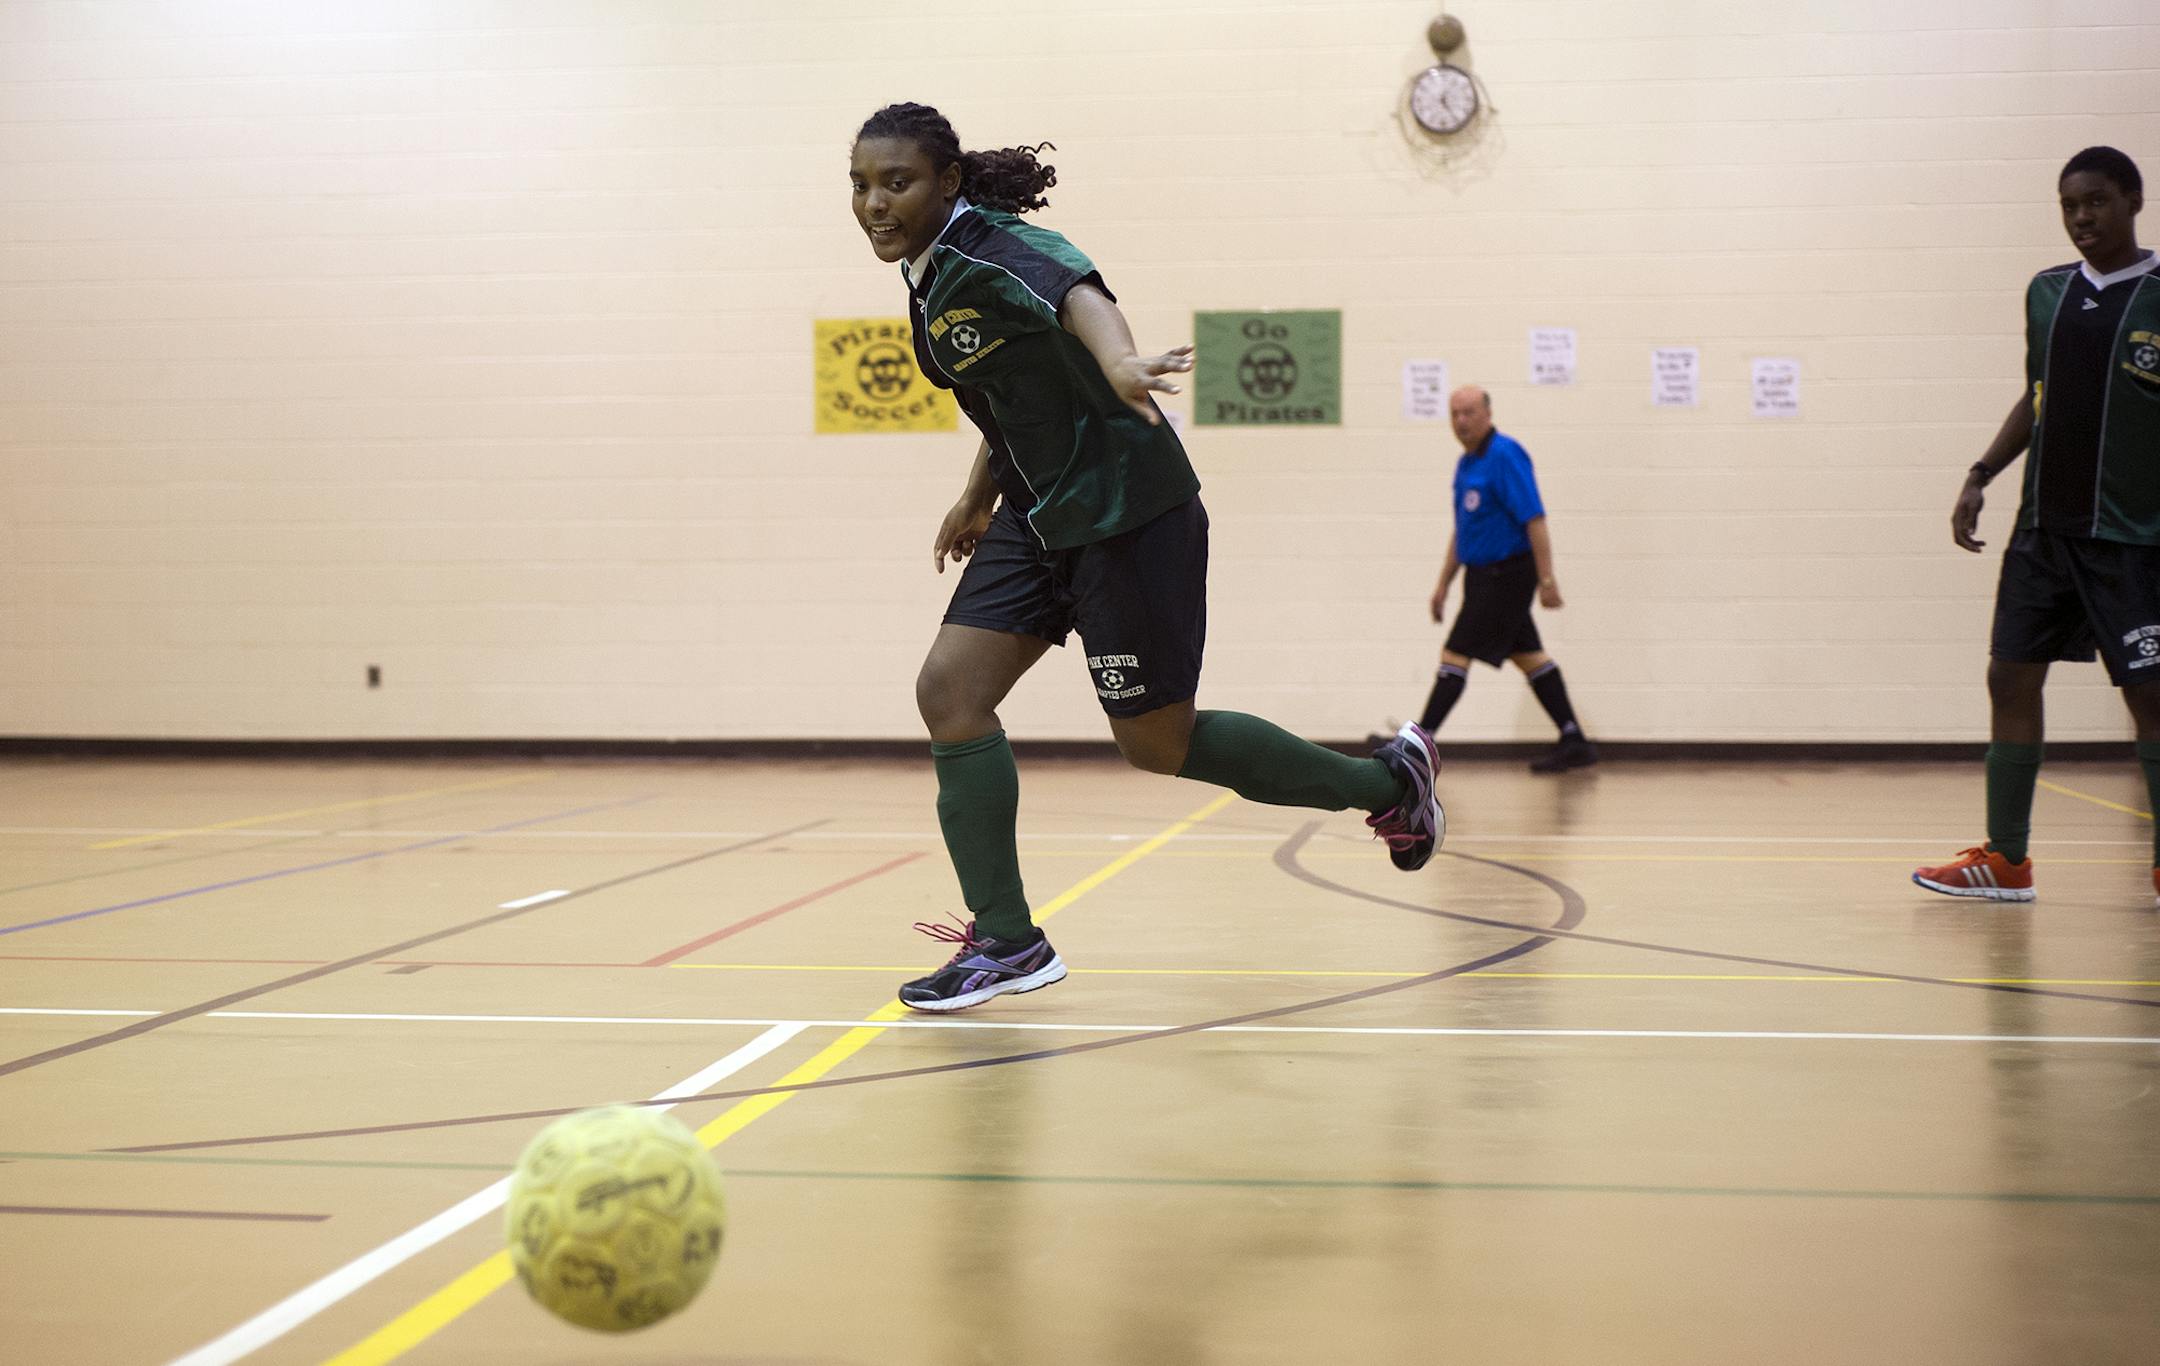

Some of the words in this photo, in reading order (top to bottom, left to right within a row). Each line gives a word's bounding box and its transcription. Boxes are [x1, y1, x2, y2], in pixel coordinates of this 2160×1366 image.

[830, 325, 913, 356] Pirat
[1241, 318, 1289, 341] Go
[832, 391, 936, 420] Soccer
[1215, 401, 1325, 422] Pirates
[1102, 654, 1139, 668] CENTER
[1119, 684, 1146, 699] SOCCER
